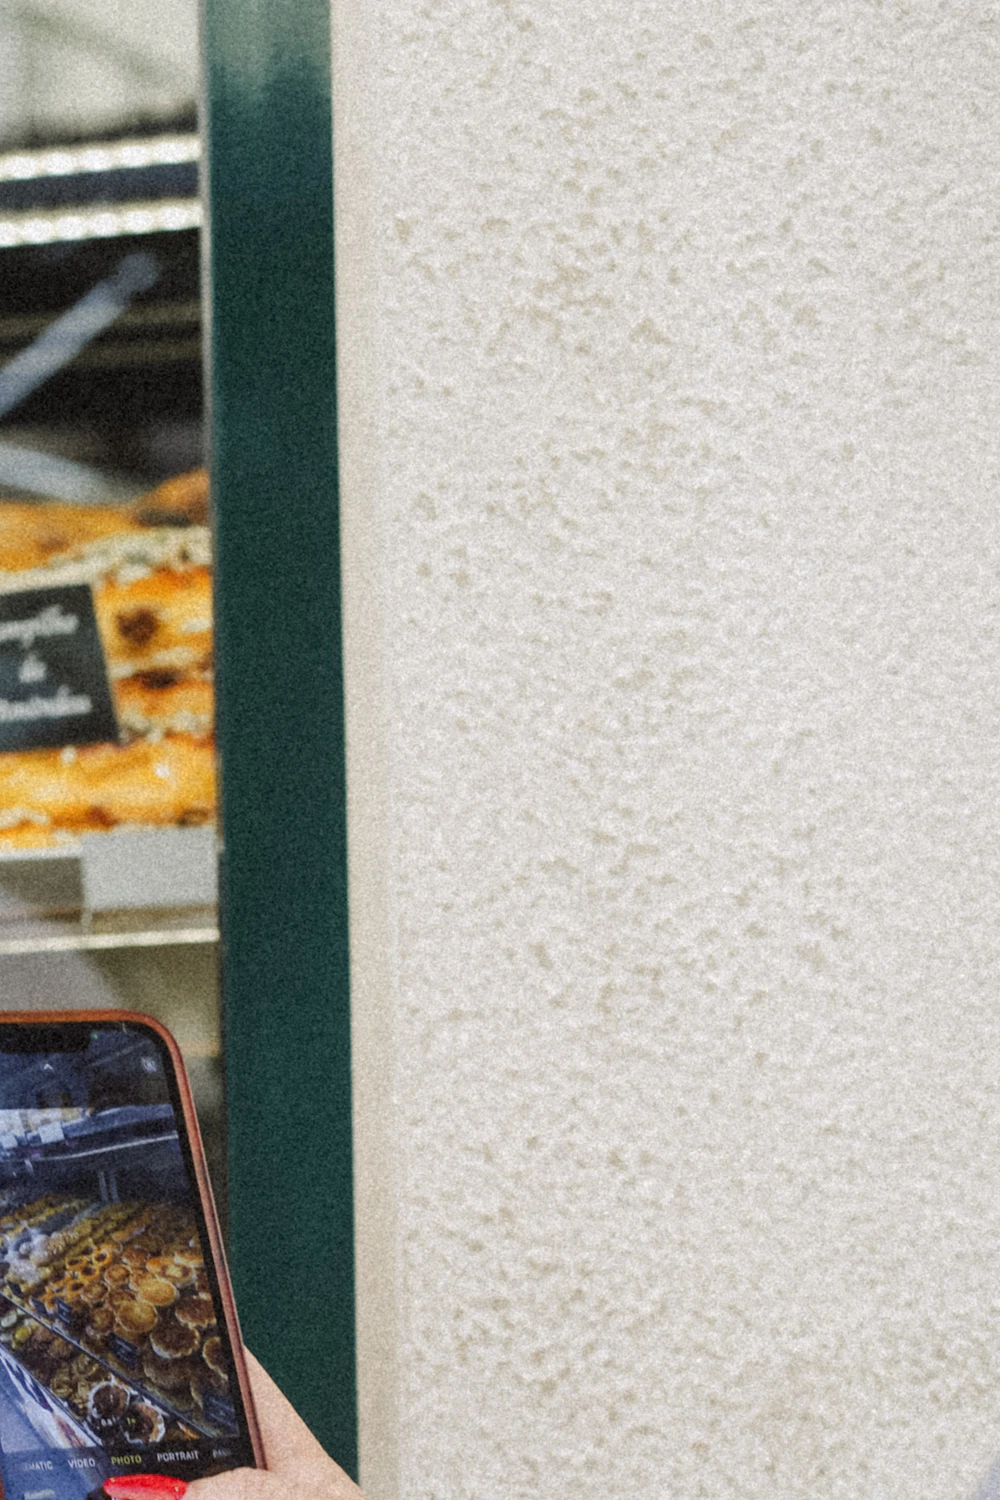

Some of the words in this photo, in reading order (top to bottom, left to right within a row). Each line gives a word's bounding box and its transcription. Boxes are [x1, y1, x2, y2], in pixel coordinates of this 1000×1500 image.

[67, 1457, 96, 1469] VIDEO
[111, 1454, 142, 1465] PHOTO
[156, 1450, 200, 1462] PORTRAIT
